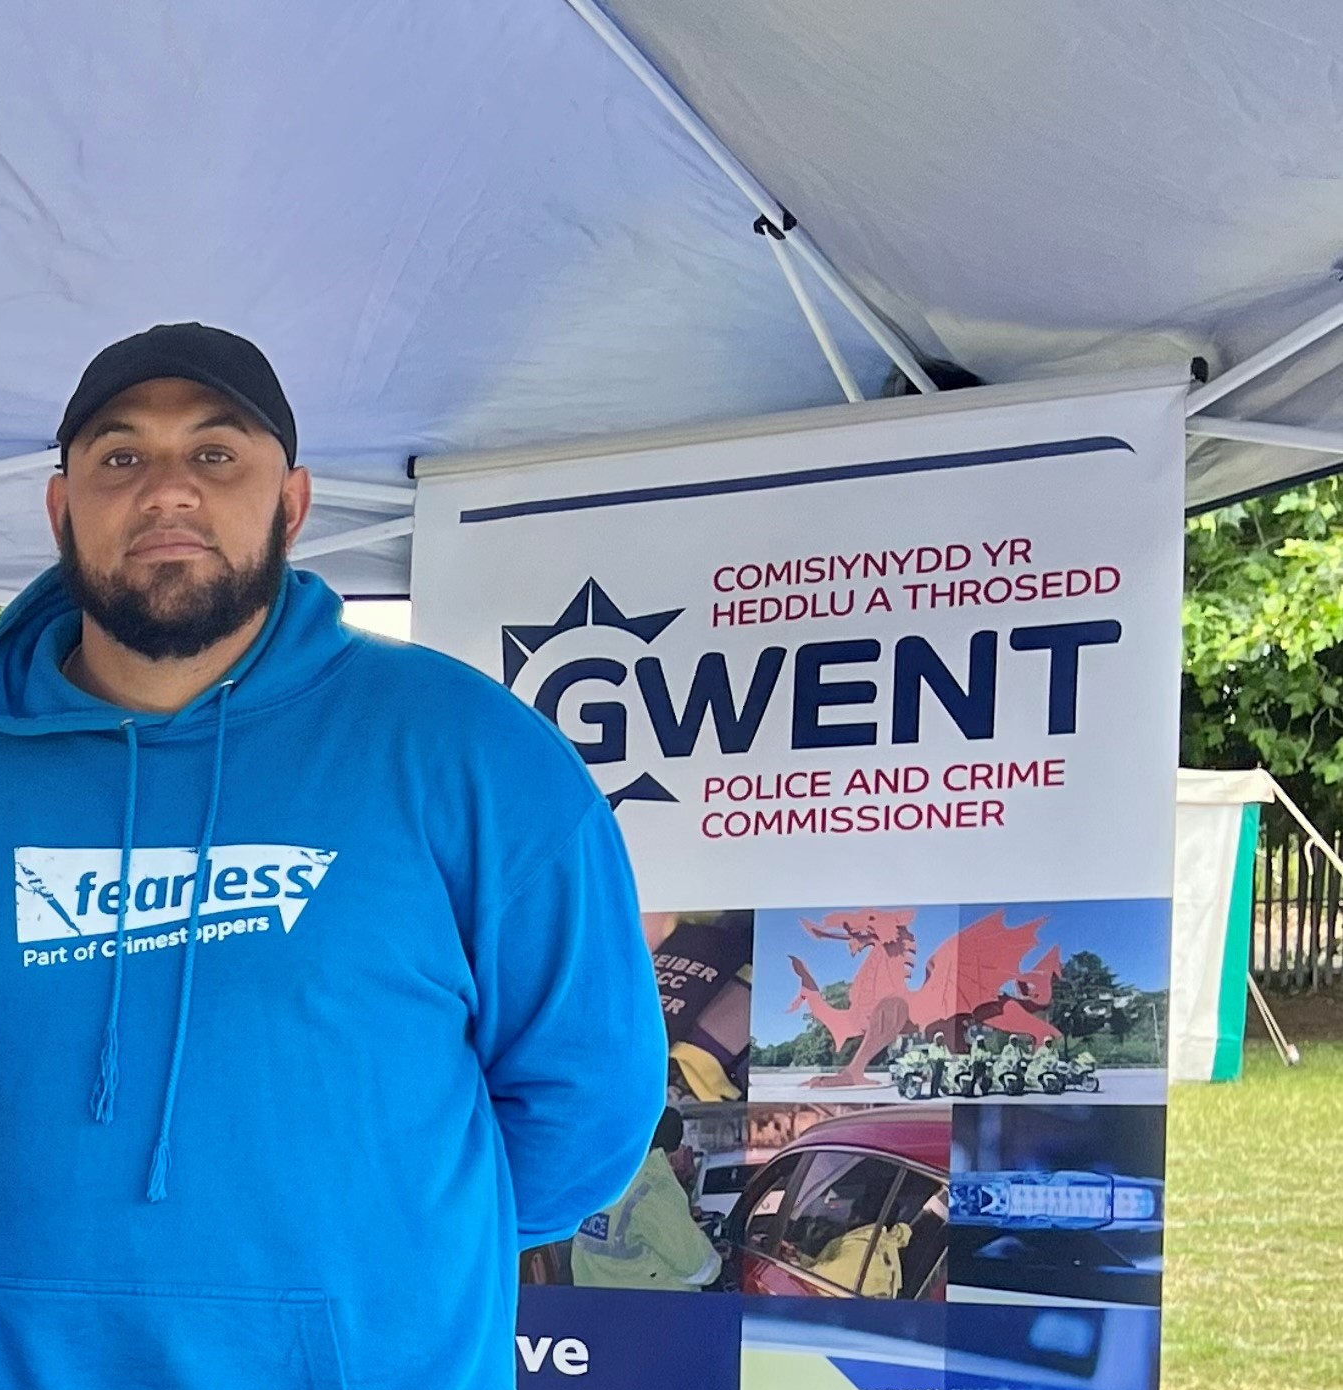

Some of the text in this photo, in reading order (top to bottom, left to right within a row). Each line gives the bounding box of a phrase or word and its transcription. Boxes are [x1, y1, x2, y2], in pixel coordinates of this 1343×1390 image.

[712, 537, 1033, 593] COMISIYNYDD YR
[712, 566, 1121, 627] HEDDLU A THROSEDD
[533, 620, 1122, 764] GWENT
[703, 759, 1066, 802] POLICE AND CRIME
[701, 801, 1005, 839] COMMISSIONER
[74, 858, 313, 916] fearless
[23, 947, 68, 968] Part
[74, 940, 97, 961] of
[653, 954, 718, 983] EIBER
